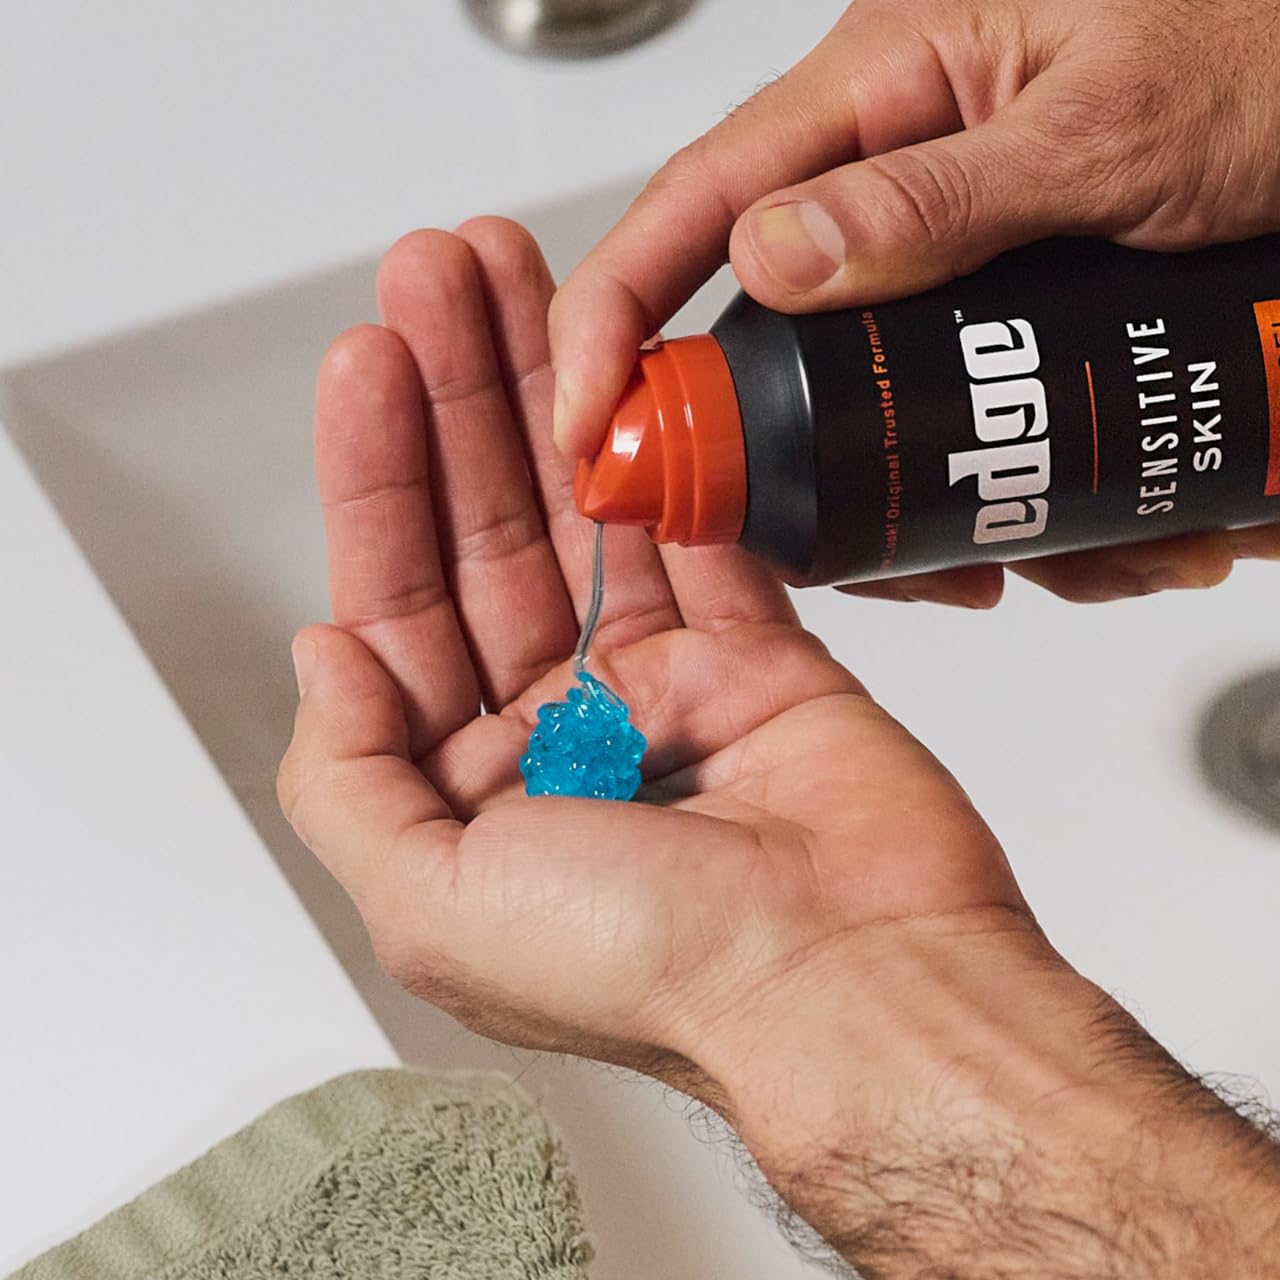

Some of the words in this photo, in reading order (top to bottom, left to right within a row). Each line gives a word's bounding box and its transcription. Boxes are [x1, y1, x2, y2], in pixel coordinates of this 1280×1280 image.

[876, 380, 898, 449] Trusted
[948, 318, 1051, 545] edge
[1126, 318, 1179, 516] SENSITIVE
[1187, 360, 1223, 472] SKIN
[886, 454, 903, 520] Original
